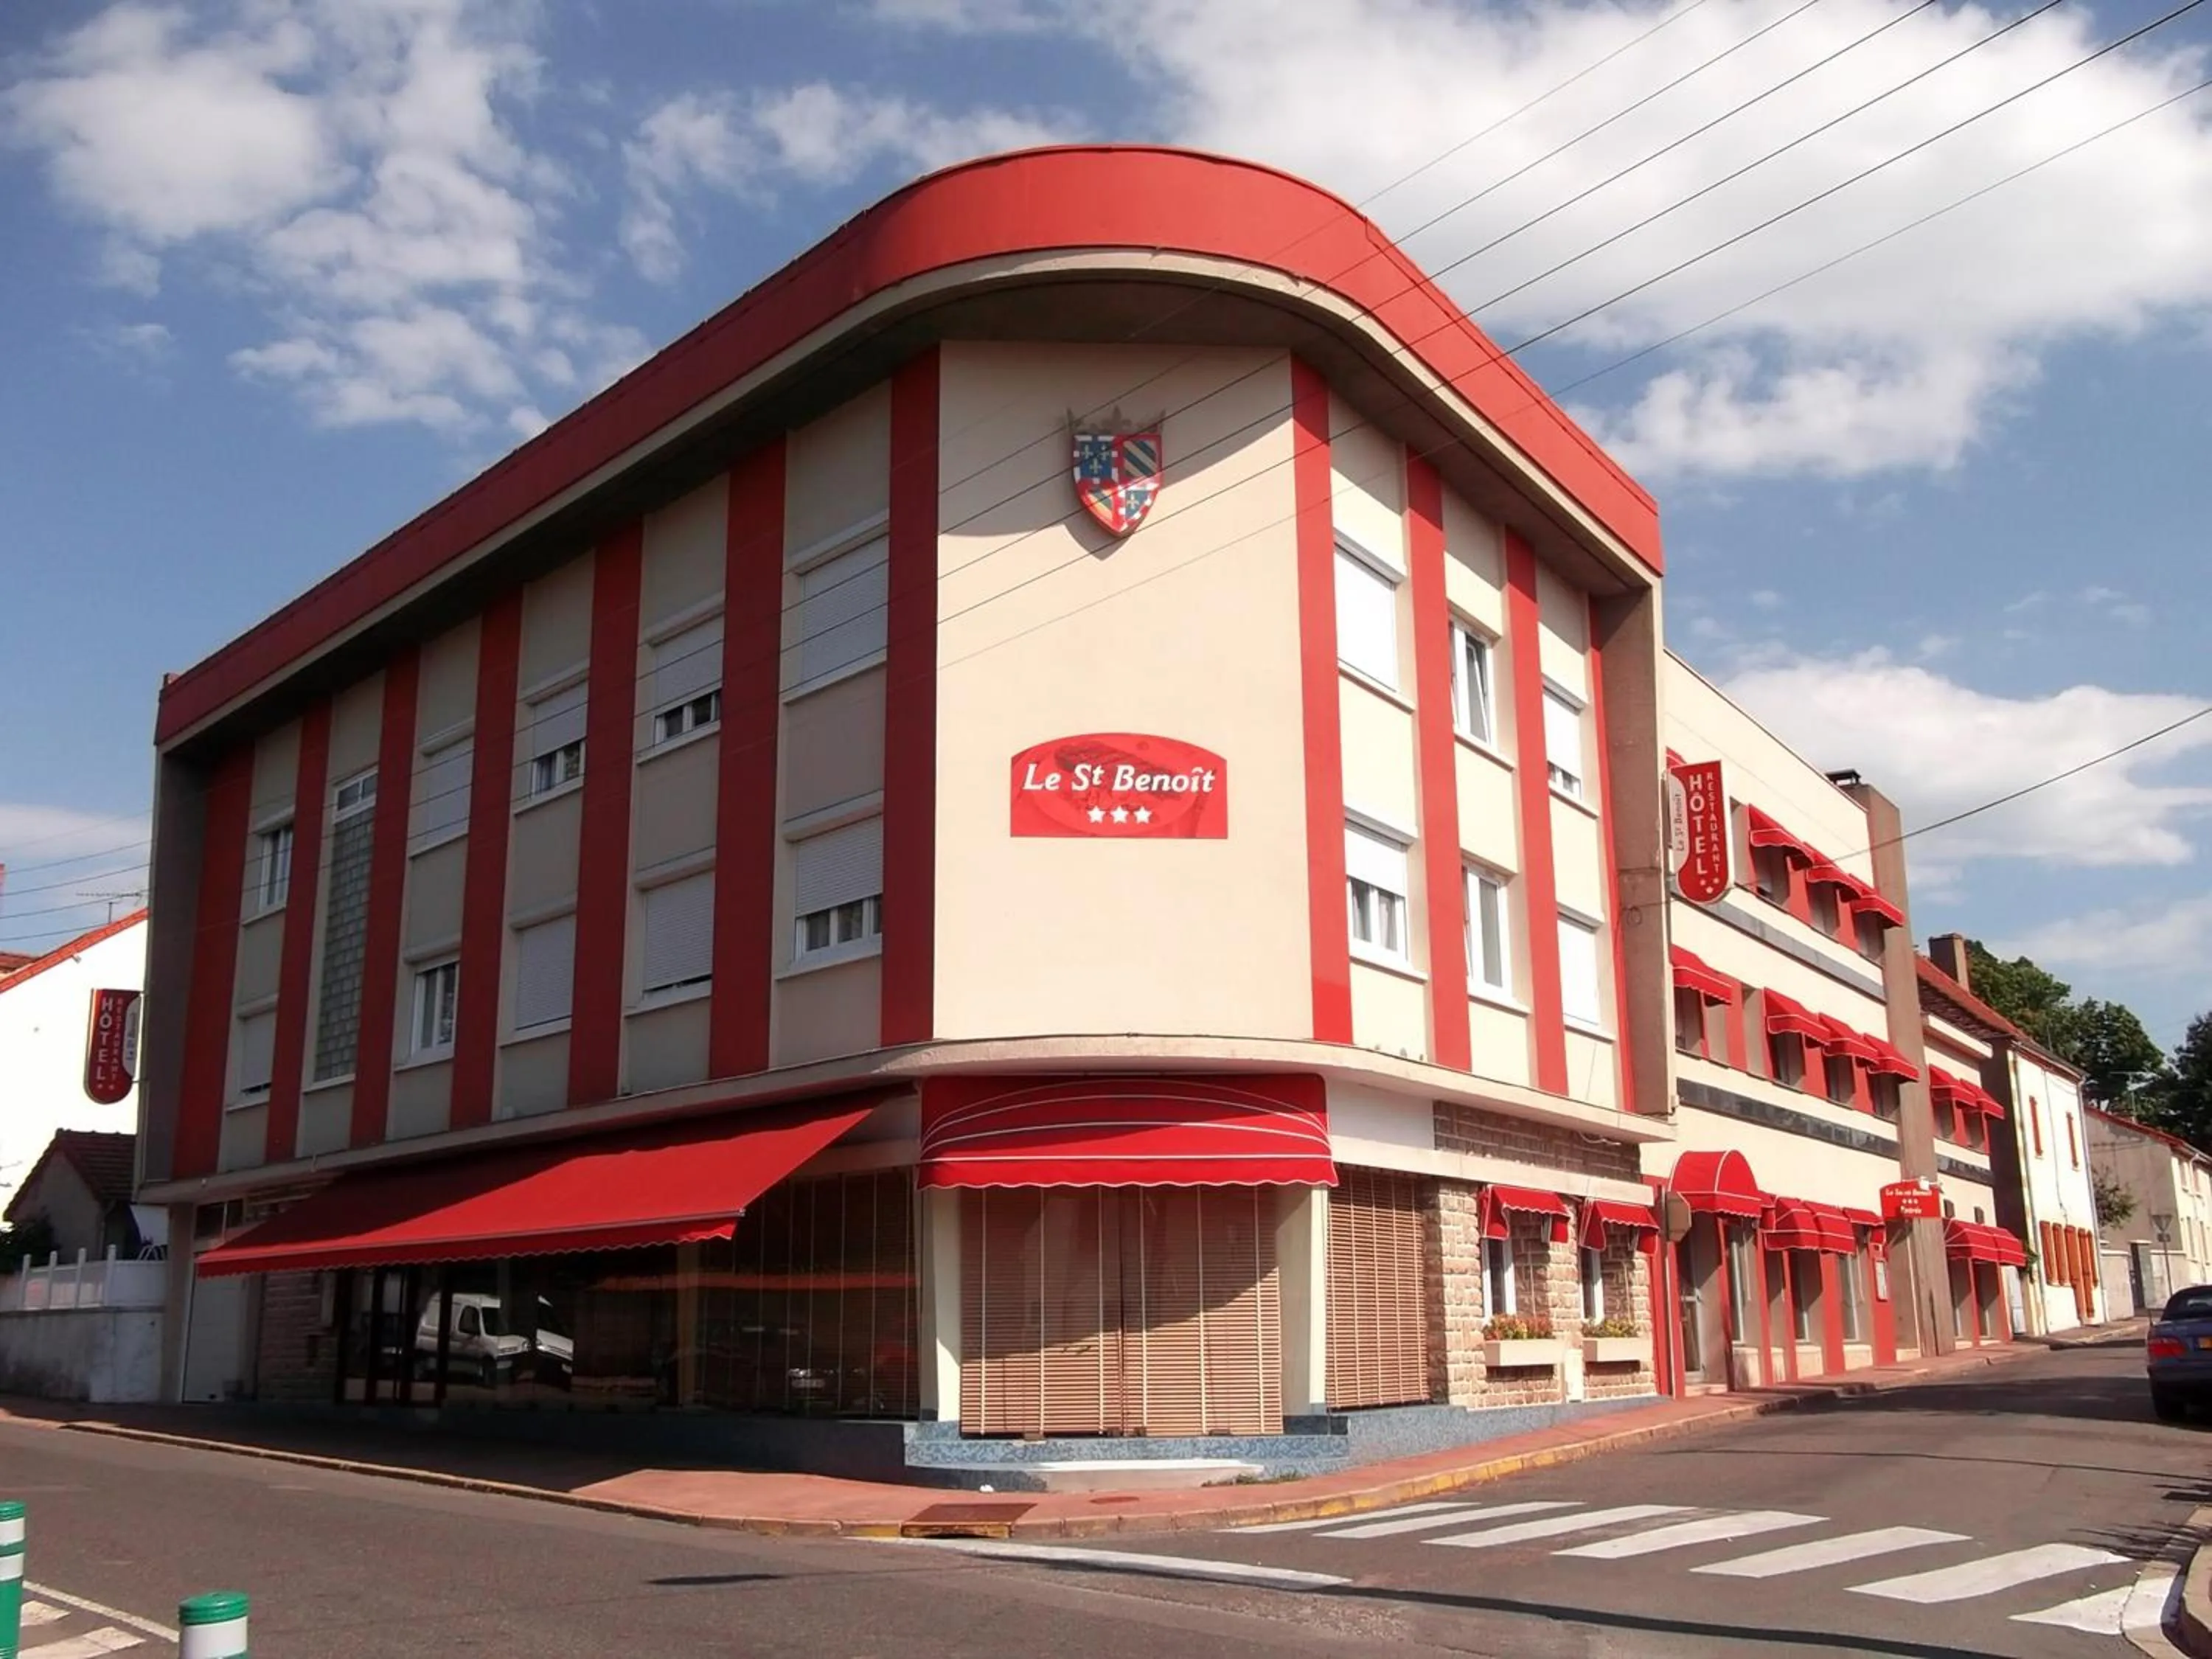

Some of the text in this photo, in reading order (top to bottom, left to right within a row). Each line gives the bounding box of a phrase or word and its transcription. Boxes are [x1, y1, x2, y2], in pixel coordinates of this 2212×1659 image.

[1023, 762, 1216, 793] Le St Benoît
[1705, 772, 1720, 874] RESTAURANT
